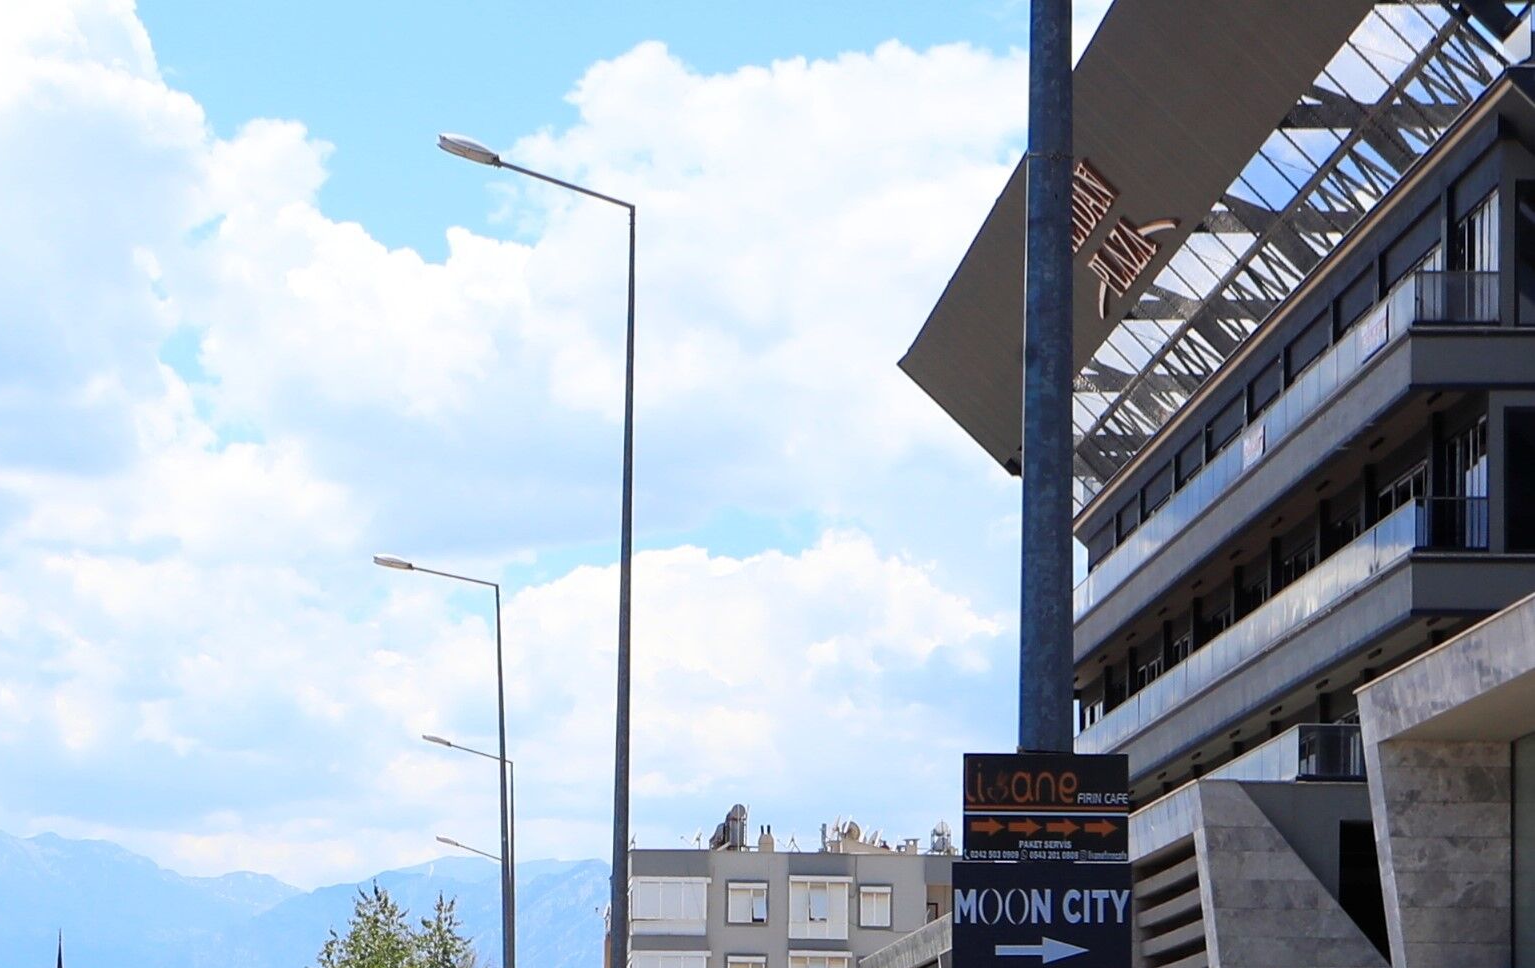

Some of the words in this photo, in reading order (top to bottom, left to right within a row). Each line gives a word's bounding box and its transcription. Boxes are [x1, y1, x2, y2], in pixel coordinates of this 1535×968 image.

[1087, 219, 1157, 298] PLAZA
[1104, 793, 1129, 804] CAFE
[953, 888, 1052, 925] MOON
[1063, 889, 1131, 924] CITY
